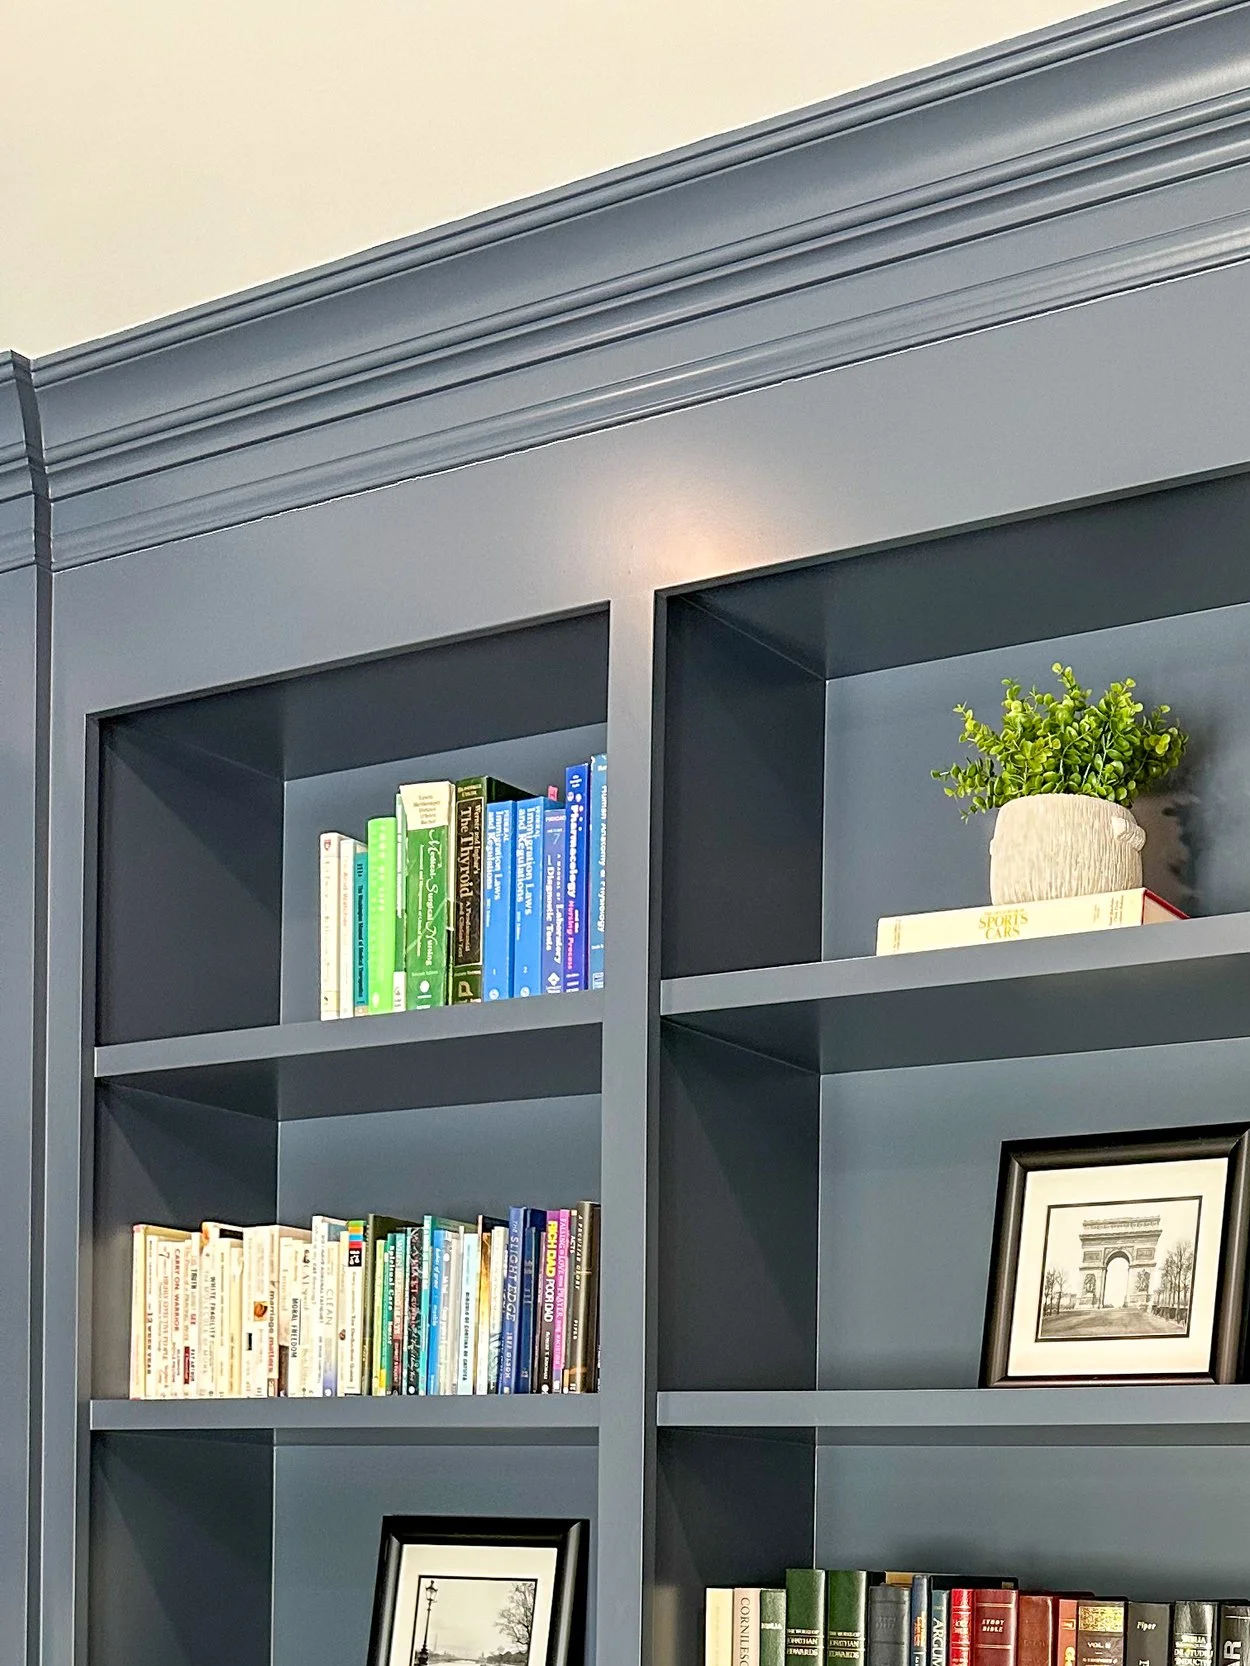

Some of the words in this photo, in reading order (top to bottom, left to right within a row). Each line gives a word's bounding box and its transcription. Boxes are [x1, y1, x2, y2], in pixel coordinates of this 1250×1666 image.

[459, 807, 472, 832] The
[517, 808, 525, 831] and
[525, 807, 534, 880] Immigration
[568, 804, 579, 898] Pharmacology
[458, 833, 473, 898] Thyroid
[516, 833, 525, 902] Regulations
[494, 874, 502, 900] Laws
[525, 883, 534, 915] Laws
[545, 866, 554, 921] Diagnostic
[978, 914, 1028, 929] SPORTS
[985, 927, 1020, 940] CARS
[425, 922, 439, 966] Nursing
[548, 1221, 558, 1248] RICH
[510, 1236, 518, 1281] SLIGHT
[546, 1250, 556, 1277] DAD
[326, 1289, 334, 1325] CLEAN
[506, 1284, 516, 1321] EDGE
[545, 1279, 555, 1303] POOR
[545, 1303, 554, 1322] DAD
